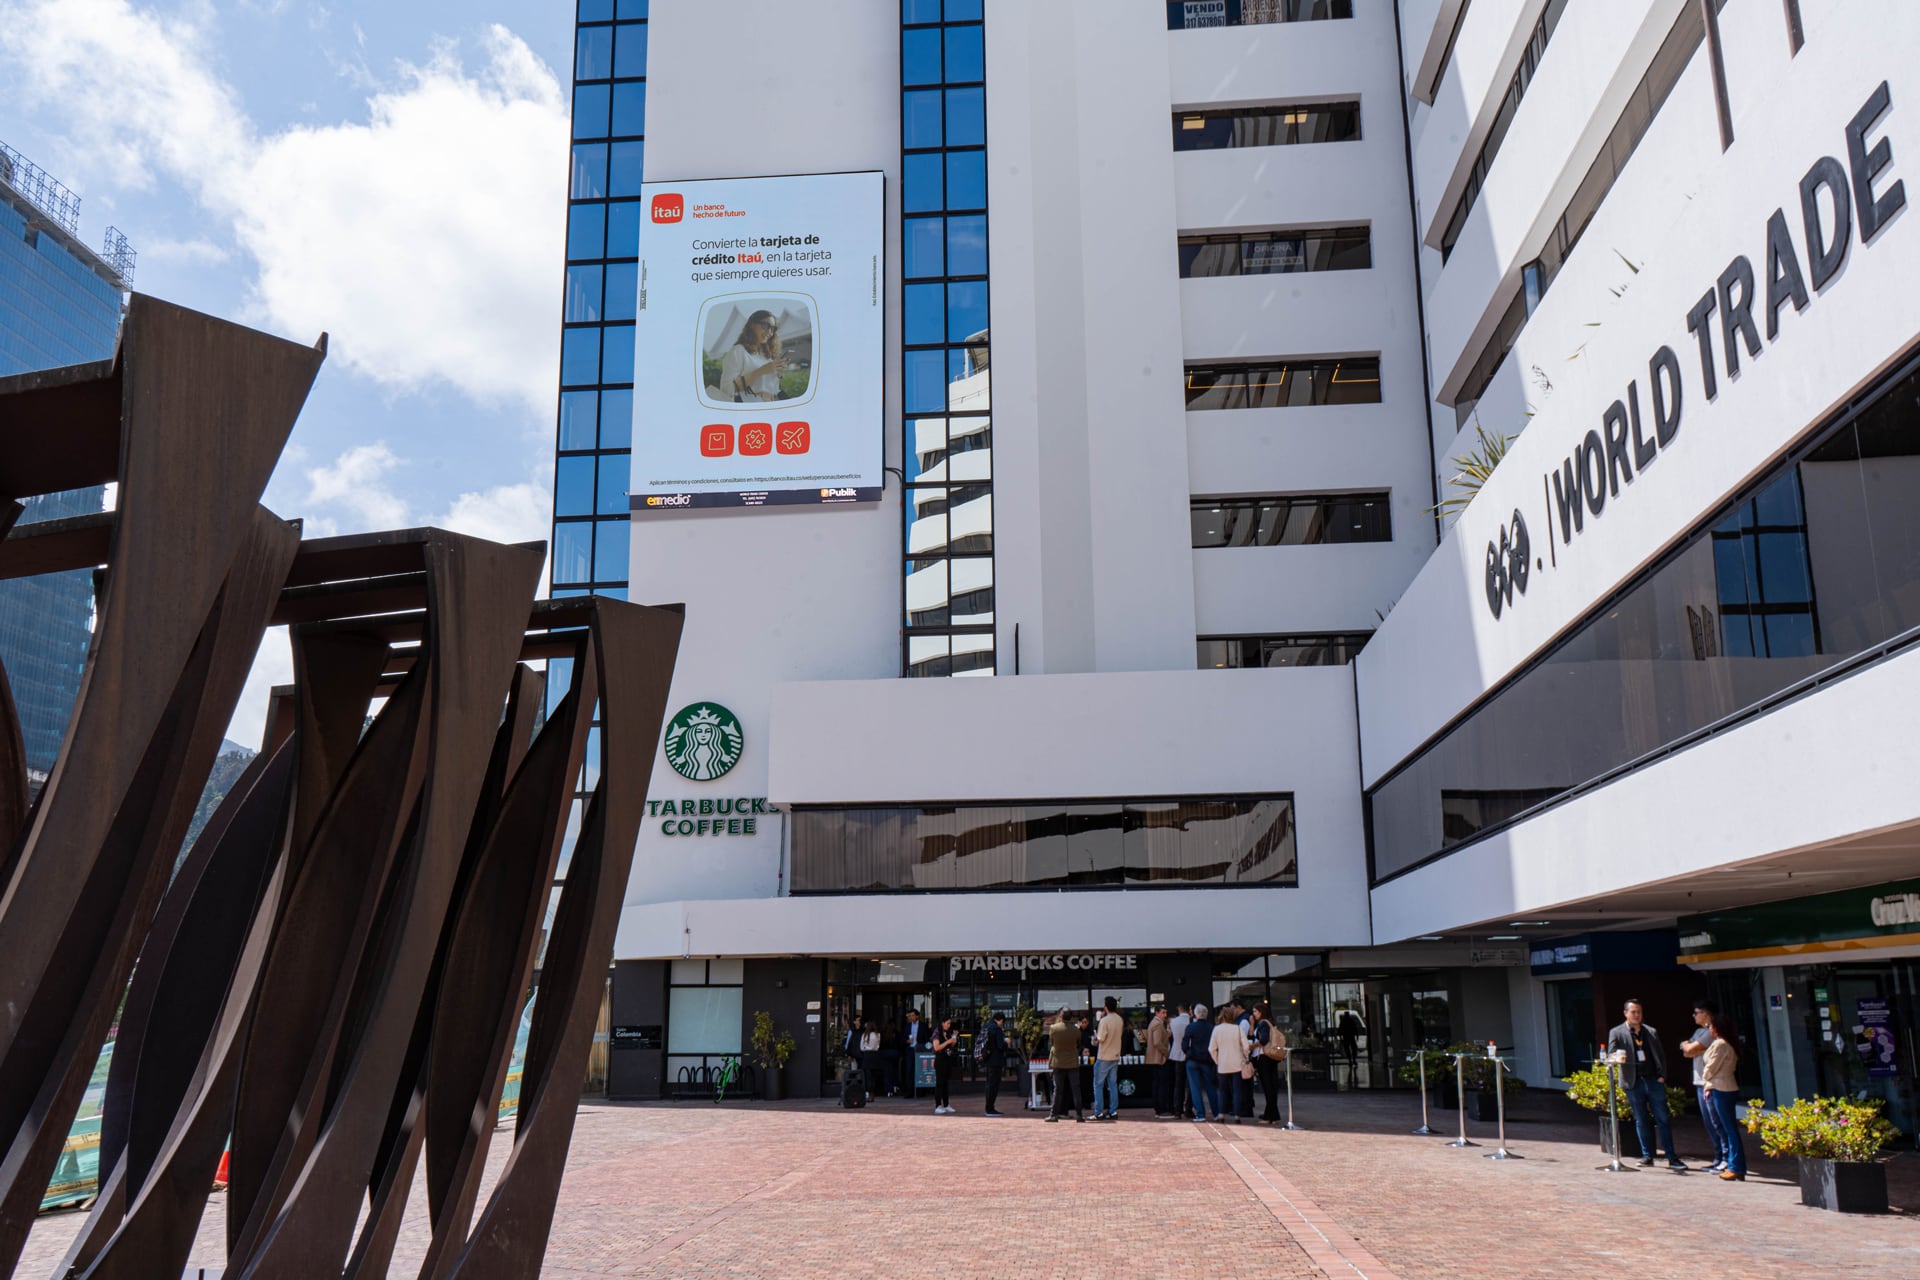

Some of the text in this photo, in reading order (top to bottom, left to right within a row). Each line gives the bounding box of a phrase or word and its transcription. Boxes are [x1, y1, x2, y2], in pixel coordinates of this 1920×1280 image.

[1185, 3, 1224, 14] VENDO
[654, 206, 680, 218] itaú
[692, 234, 820, 250] Convierte la tarjeta de
[692, 250, 832, 265] crédito Itaú, en la tarjeta
[691, 266, 832, 283] que siempre quieres usar.
[1552, 80, 1907, 545] WORLD TRADE
[829, 488, 857, 497] Publik
[646, 797, 781, 816] TARBUCK
[662, 818, 757, 836] COFFEE
[950, 954, 1137, 971] STARBUCKS COFFEE
